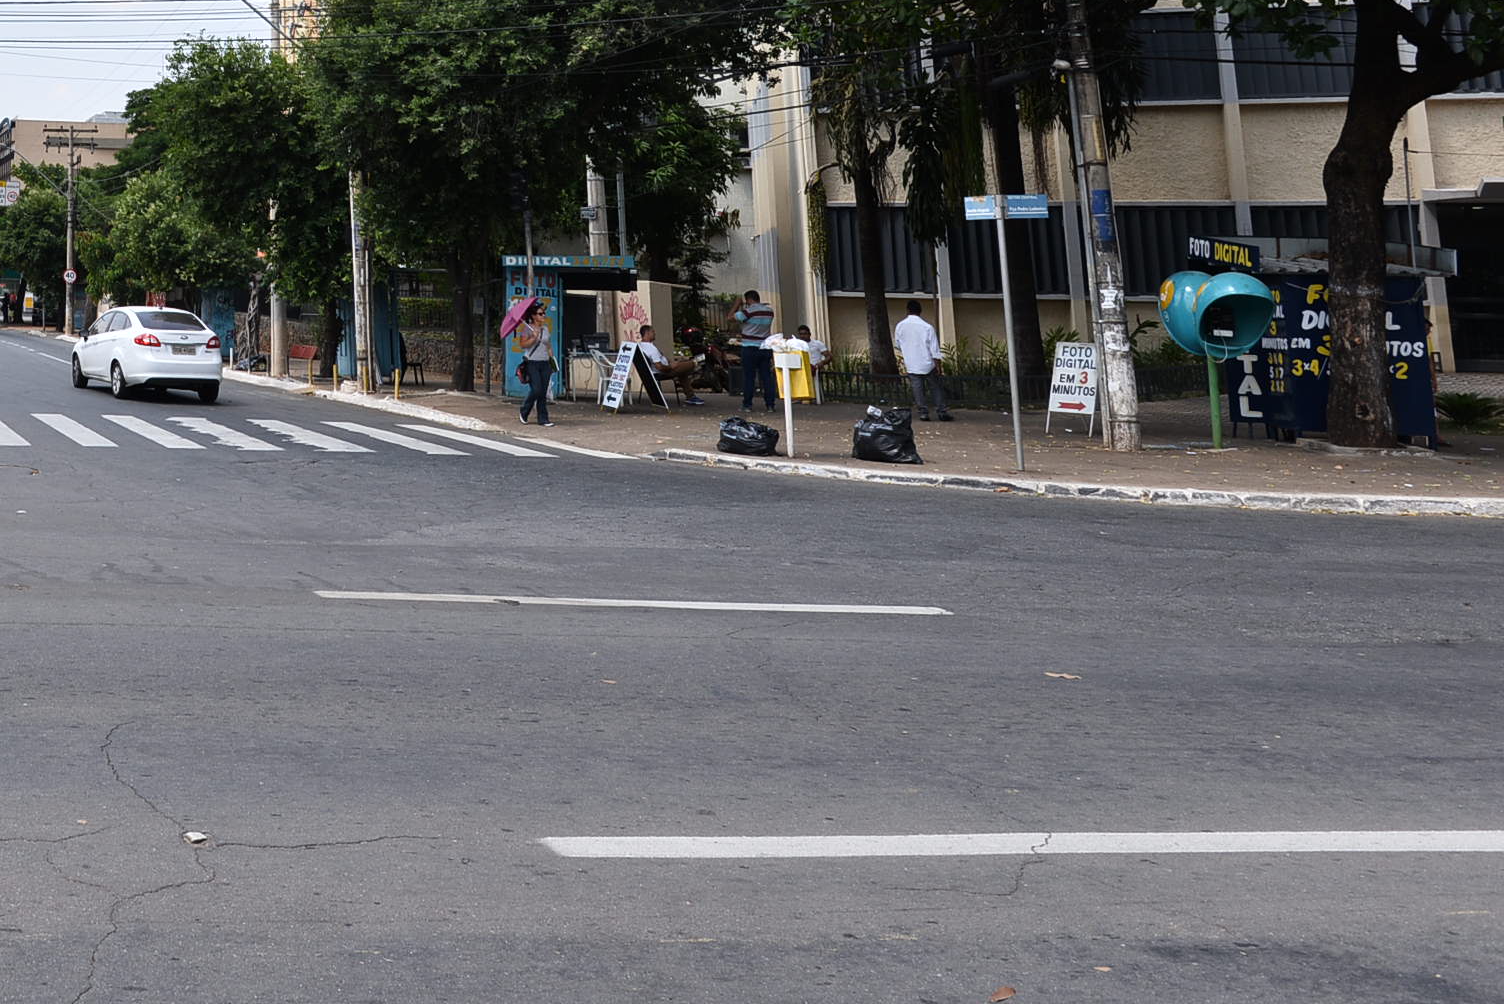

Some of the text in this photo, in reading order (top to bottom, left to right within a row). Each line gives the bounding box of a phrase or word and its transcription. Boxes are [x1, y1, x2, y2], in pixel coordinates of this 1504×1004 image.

[1189, 237, 1253, 267] FOTO DIGITAL
[515, 287, 556, 297] DIITAL
[1291, 337, 1311, 349] EM
[1062, 346, 1093, 357] FOTO
[1055, 358, 1096, 370] DIGITAL
[1059, 371, 1089, 385] EM 3
[1052, 384, 1096, 397] MINUTOS
